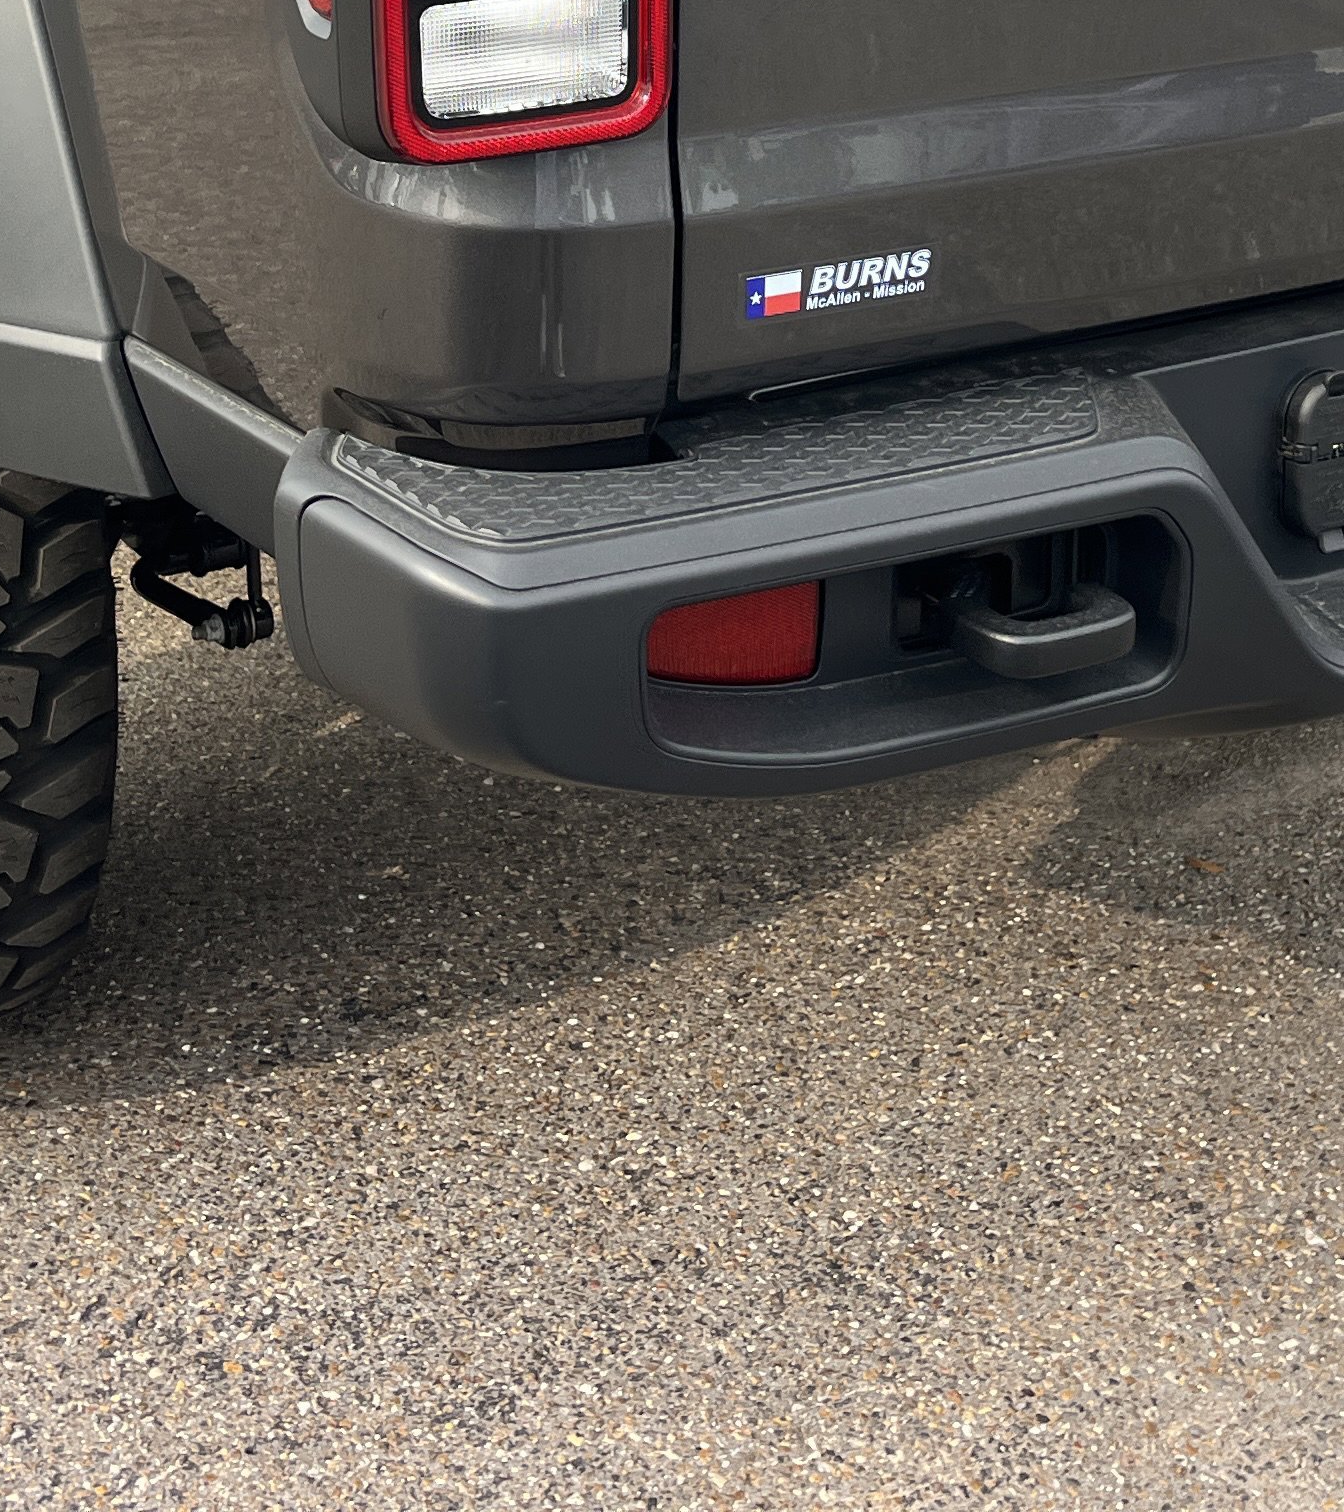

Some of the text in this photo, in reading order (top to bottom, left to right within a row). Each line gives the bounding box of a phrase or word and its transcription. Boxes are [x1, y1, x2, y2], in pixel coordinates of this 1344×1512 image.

[809, 248, 932, 295] BURNS
[806, 280, 925, 311] McAllen Mission
